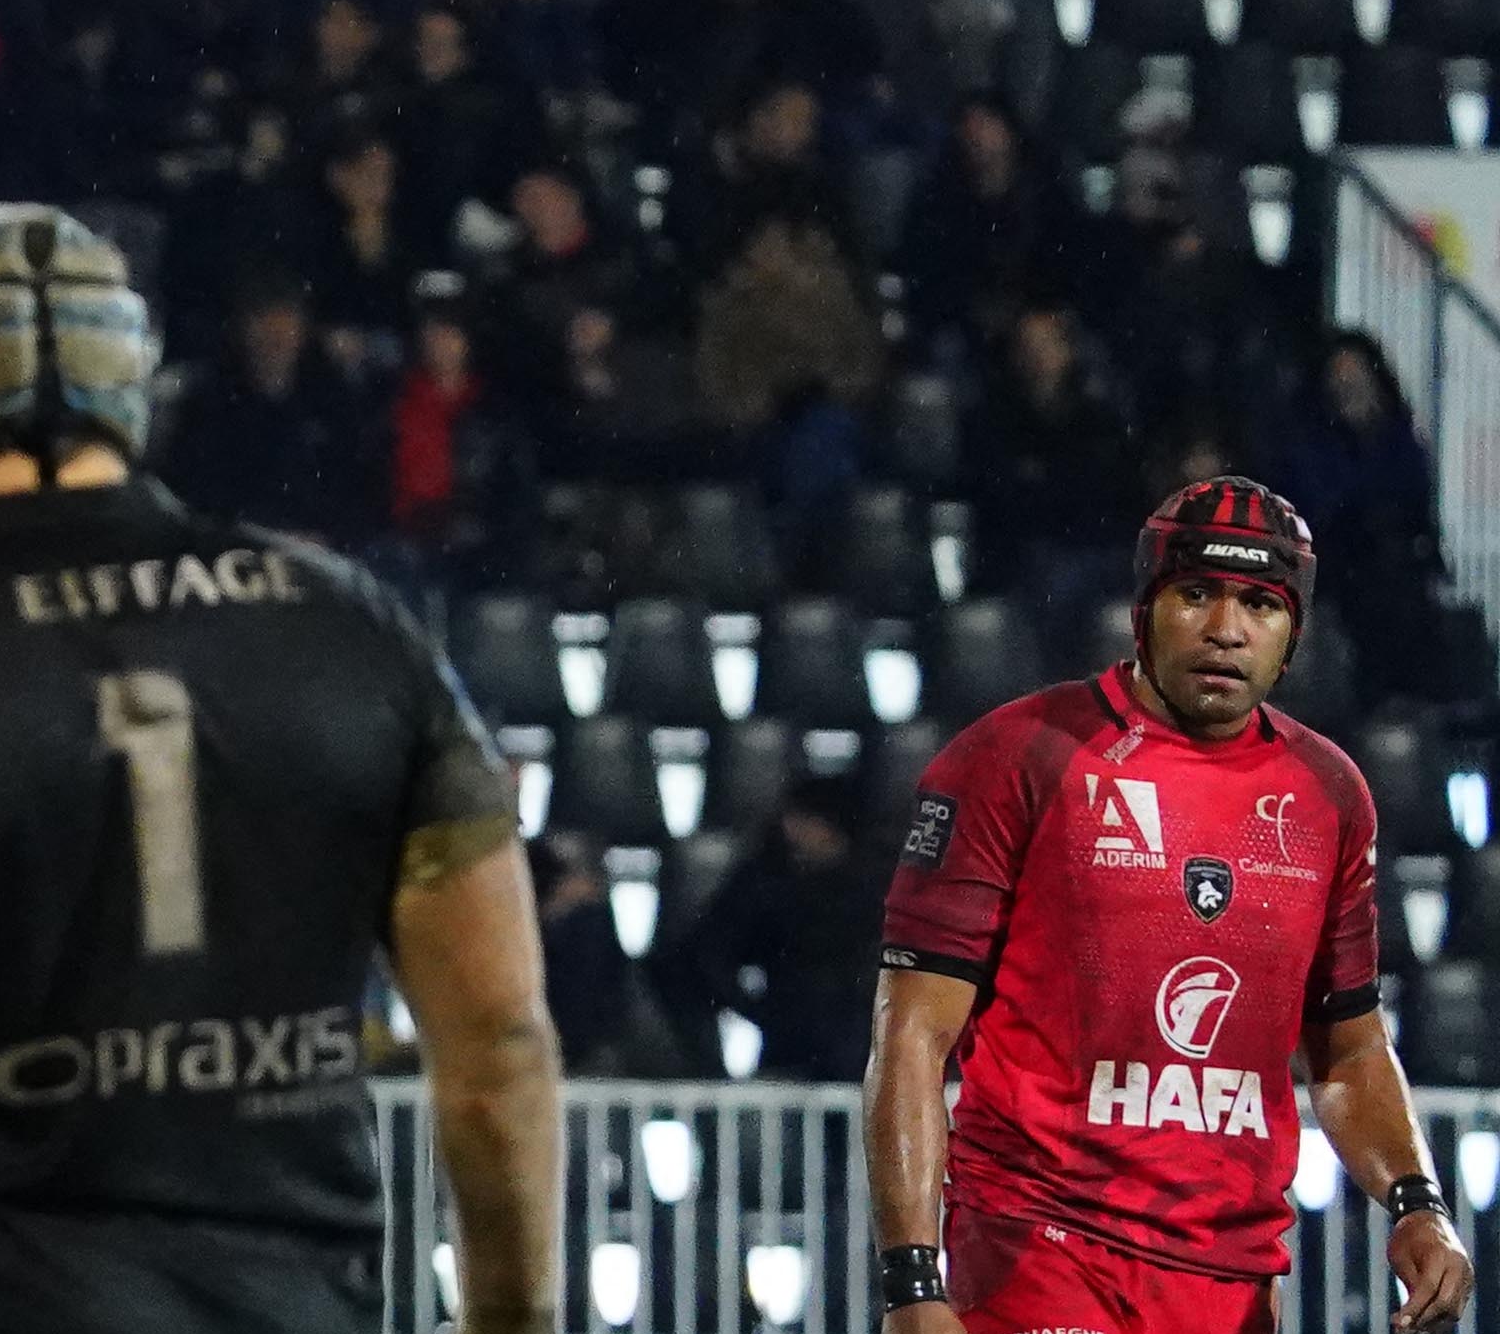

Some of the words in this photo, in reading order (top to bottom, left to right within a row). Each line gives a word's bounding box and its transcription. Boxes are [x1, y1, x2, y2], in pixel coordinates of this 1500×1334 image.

[1202, 543, 1269, 564] IMPACT
[96, 669, 209, 956] 1
[1092, 849, 1167, 870] ADERIM
[1087, 1059, 1270, 1140] HAFA
